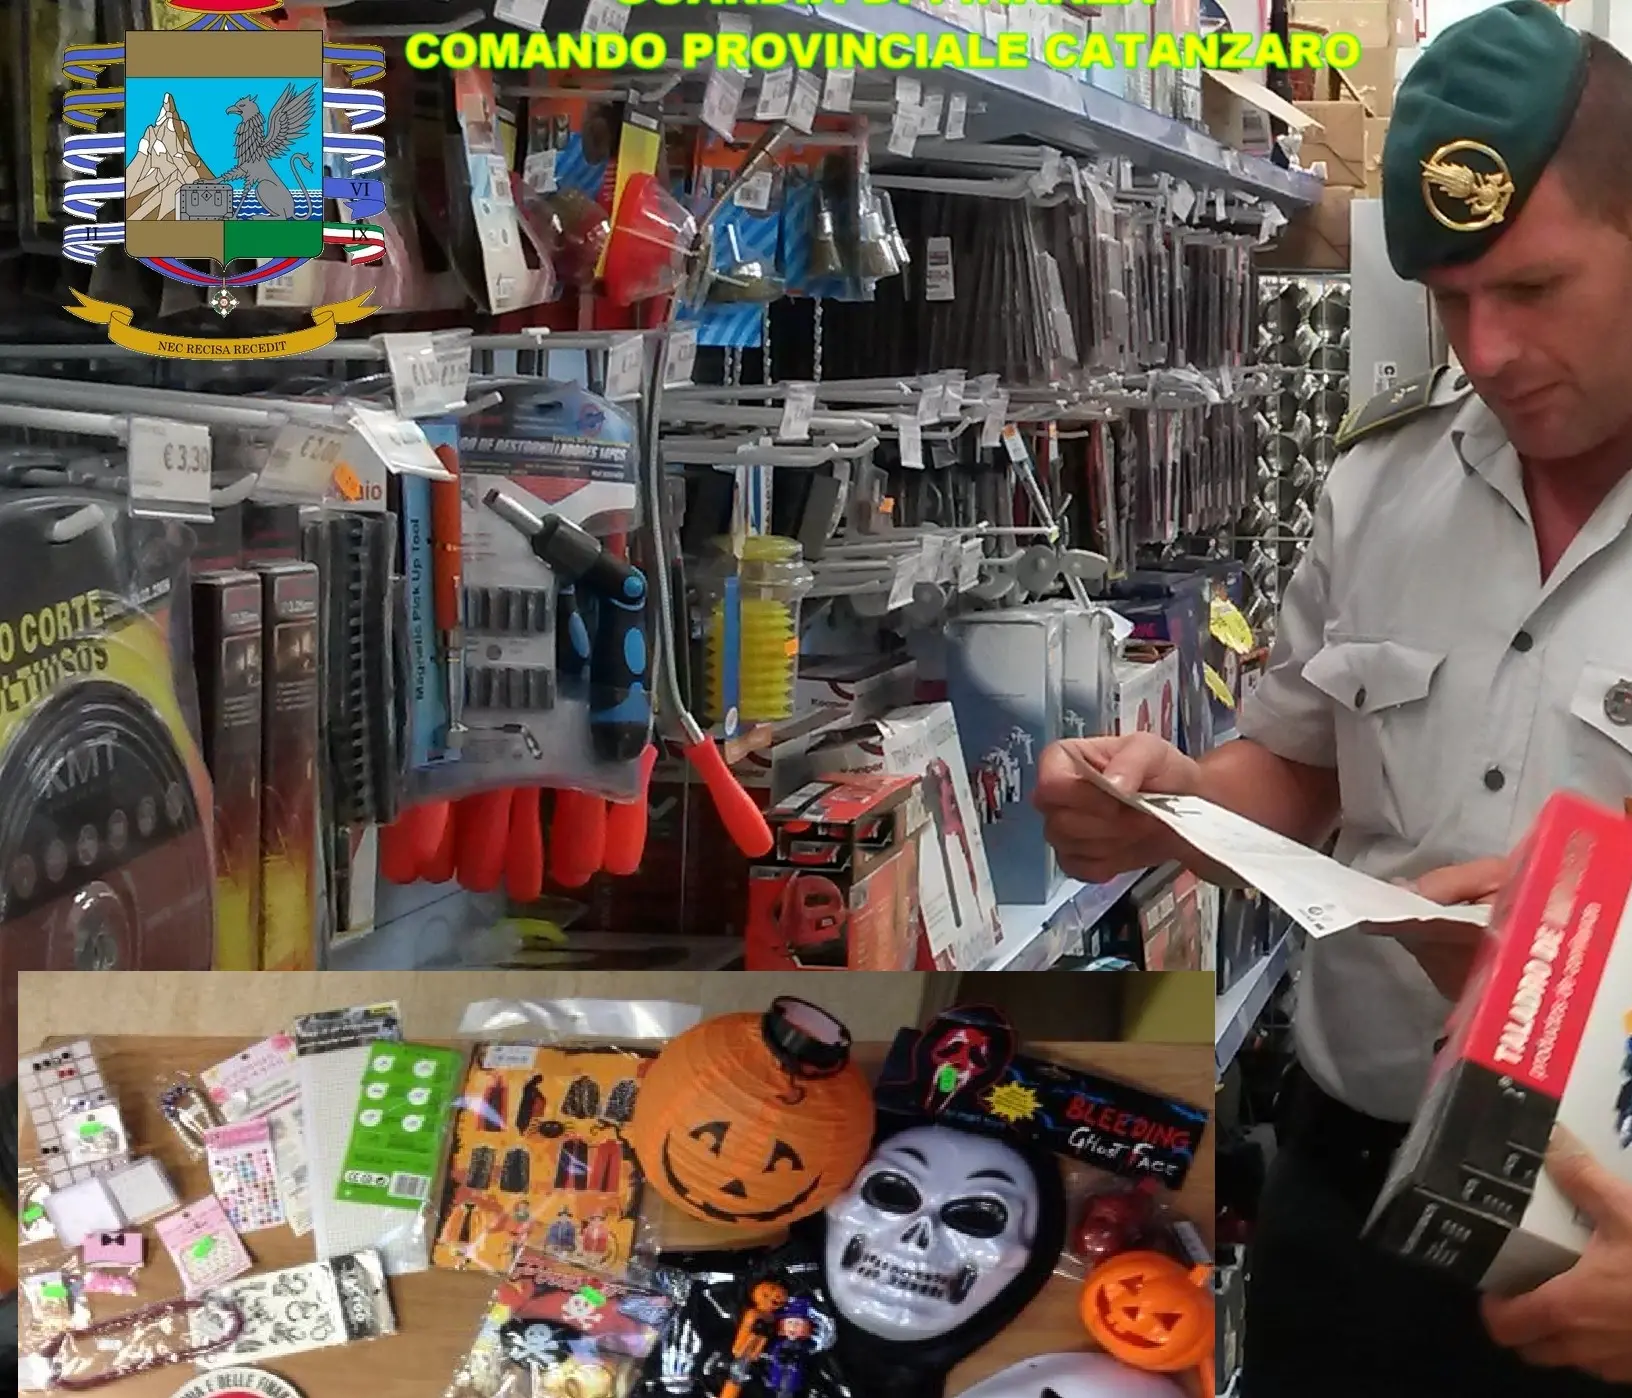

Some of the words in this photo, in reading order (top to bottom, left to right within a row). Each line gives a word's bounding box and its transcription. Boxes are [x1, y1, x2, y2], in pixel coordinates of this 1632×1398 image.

[20, 588, 104, 654] CORTE
[1493, 958, 1553, 1065] TALADRO
[1065, 1093, 1192, 1153] BLEEDING
